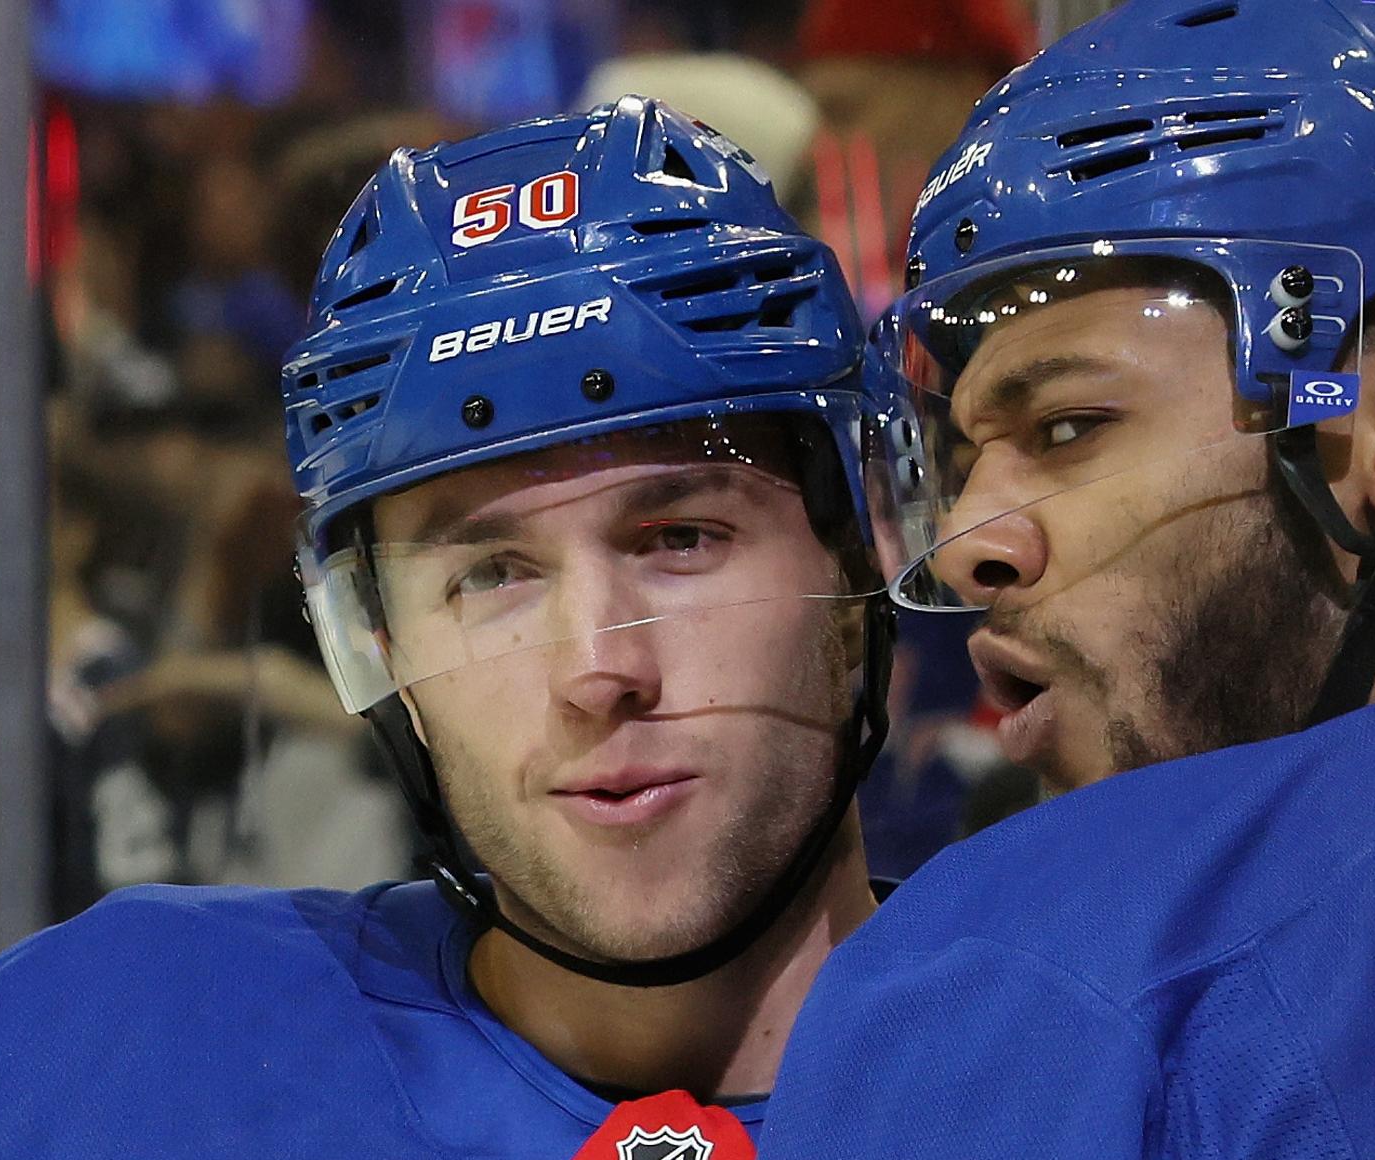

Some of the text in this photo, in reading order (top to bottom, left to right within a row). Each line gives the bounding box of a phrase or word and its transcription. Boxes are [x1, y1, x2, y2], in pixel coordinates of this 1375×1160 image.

[452, 170, 579, 248] 50
[429, 296, 612, 363] BAUER
[1295, 395, 1354, 407] OAKLEY
